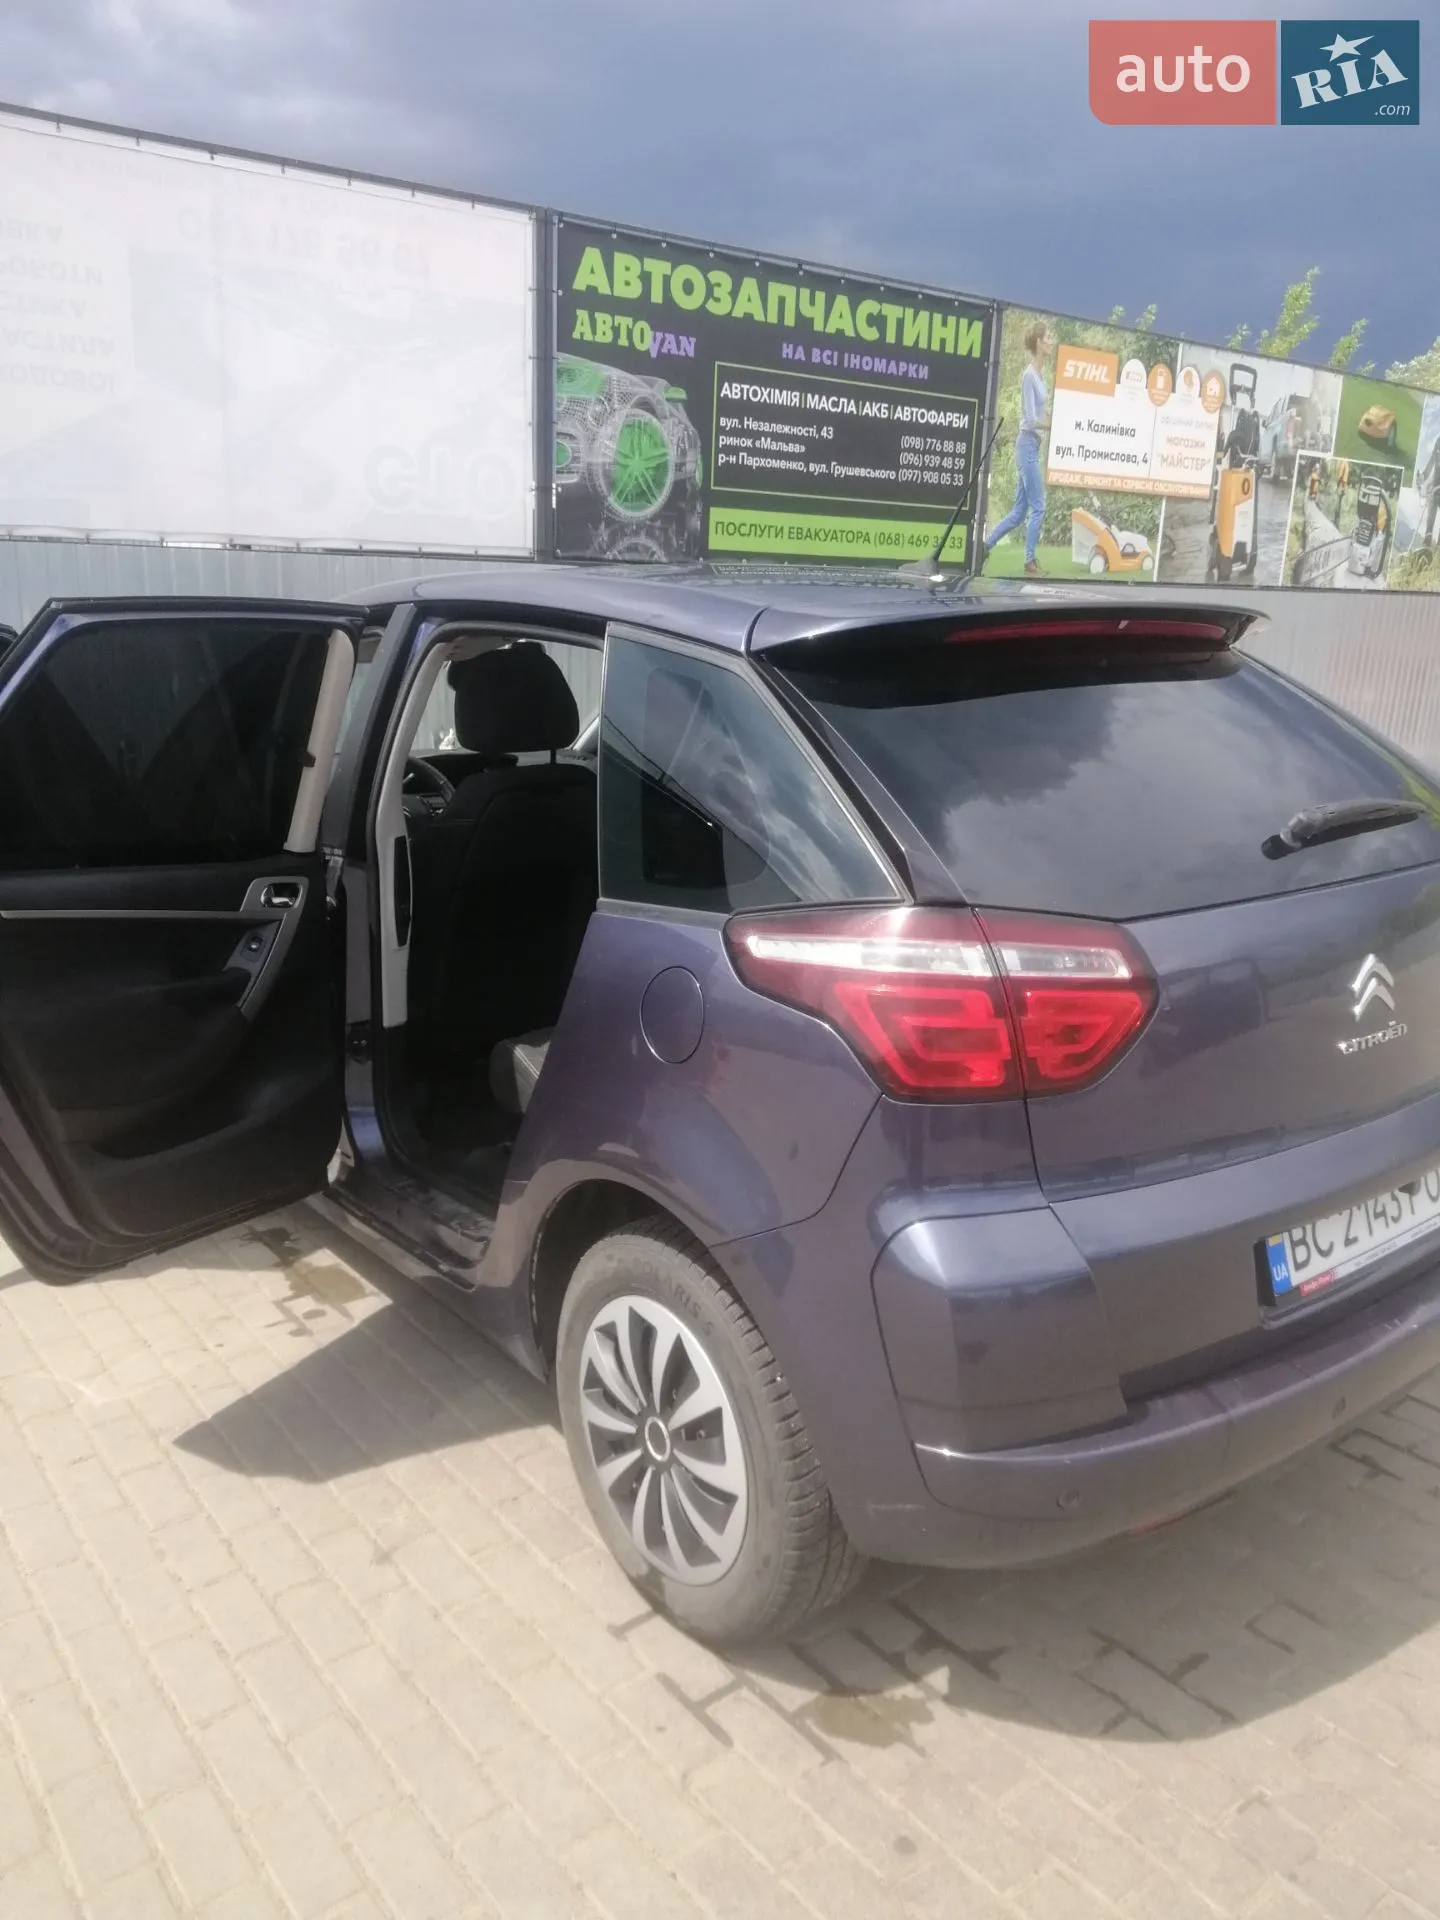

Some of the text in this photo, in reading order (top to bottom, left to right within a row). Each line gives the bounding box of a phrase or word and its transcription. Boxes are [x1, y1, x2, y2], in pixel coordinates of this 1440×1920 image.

[572, 246, 984, 358] АВТОЗАПЧАСТИНИ
[781, 342, 930, 380] НА ВСІ ІНОМАРКИ
[1063, 359, 1111, 384] STIHL
[720, 382, 970, 429] АВТОХІМІЯ МАСЛА АКБ АВТОФАРБИ
[719, 416, 742, 429] вул.
[820, 426, 834, 440] 43
[1074, 419, 1136, 438] м. Калинівка
[719, 435, 806, 454] ринок «Мальва»
[901, 435, 967, 454] (098) 776 88 88
[1055, 445, 1148, 466] вул. Промислова, 4
[718, 453, 896, 481] р-н Пархоменко, вул. Грушевського
[899, 452, 965, 471] (096) 939 48 59
[898, 469, 964, 486] (097) 908 05 33
[715, 521, 963, 551] ПОСЛУГИ ЕВАКУАТОРА (068) 469 3 33
[1289, 1220, 1334, 1272] BC
[1272, 1263, 1290, 1281] UA
